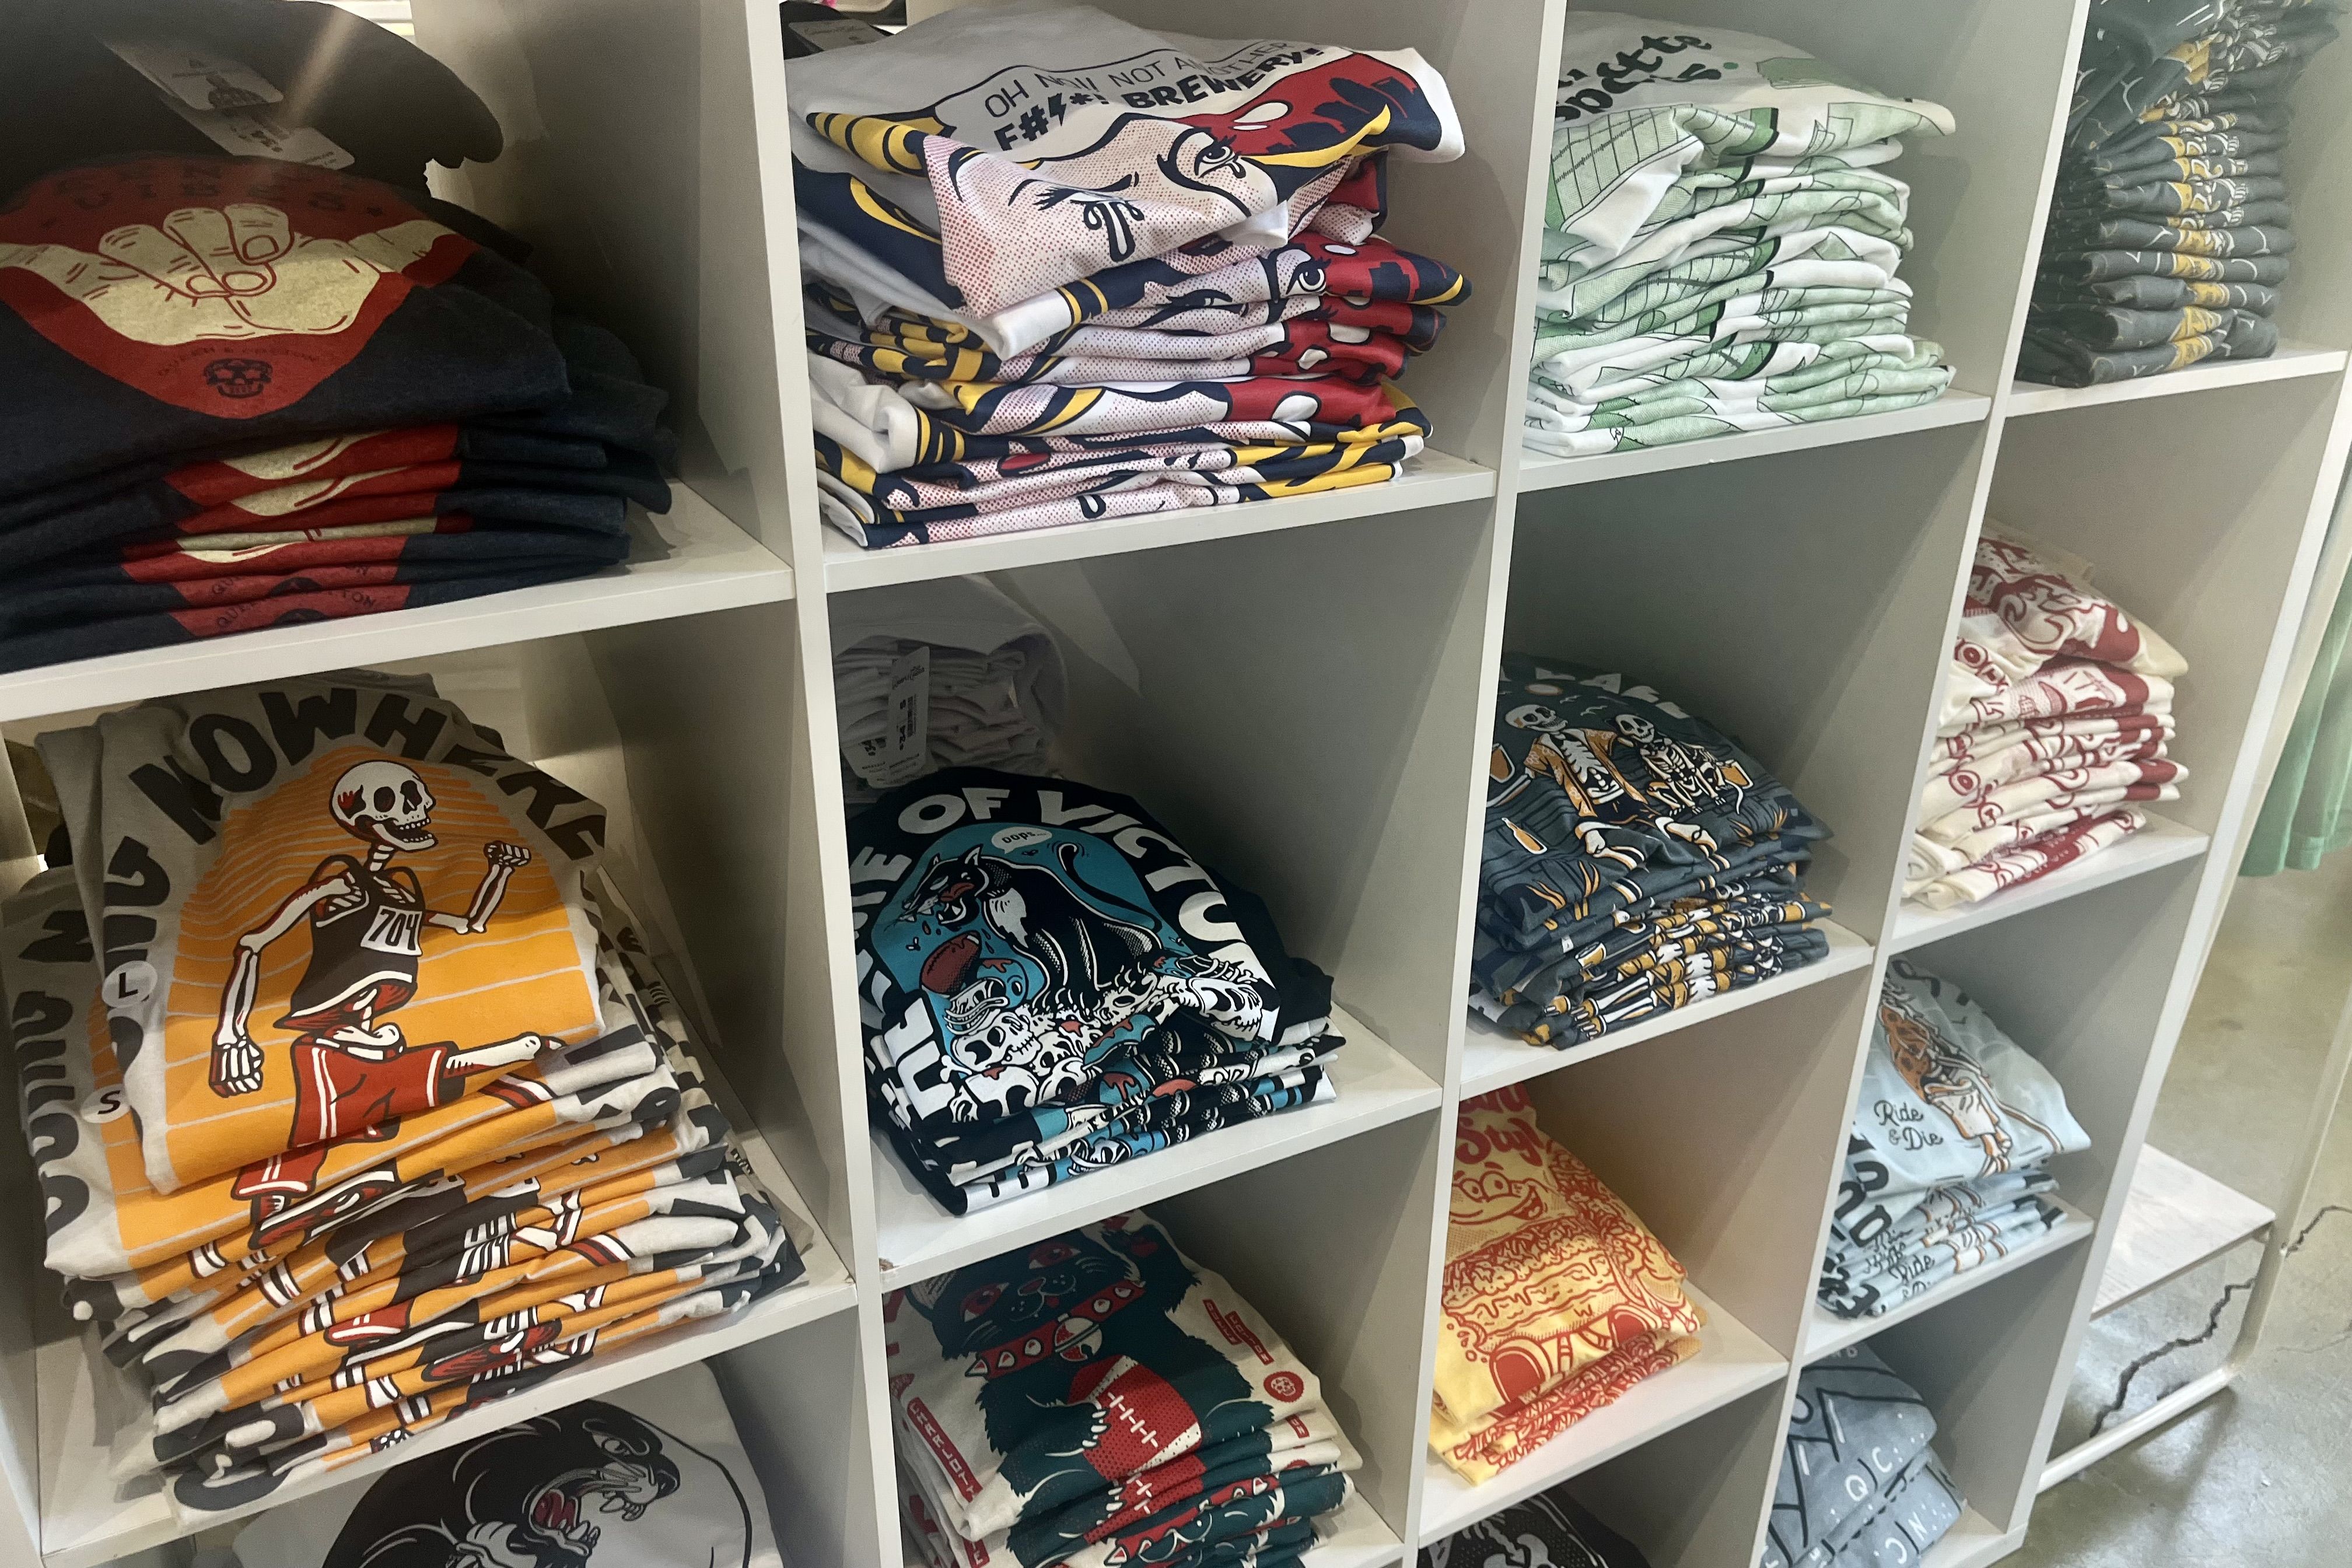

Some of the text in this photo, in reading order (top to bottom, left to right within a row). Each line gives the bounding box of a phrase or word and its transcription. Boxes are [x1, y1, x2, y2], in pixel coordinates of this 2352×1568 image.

[985, 79, 1029, 117] OH
[1108, 60, 1167, 88] NOT
[1121, 47, 1325, 108] BREWERY!
[898, 788, 1010, 835] OF
[368, 908, 420, 951] 704
[118, 972, 138, 998] L
[97, 1090, 121, 1115] S
[1874, 1100, 1924, 1126] Ride
[1902, 1126, 1944, 1150] Die
[909, 1402, 975, 1494] CHARLOTT
